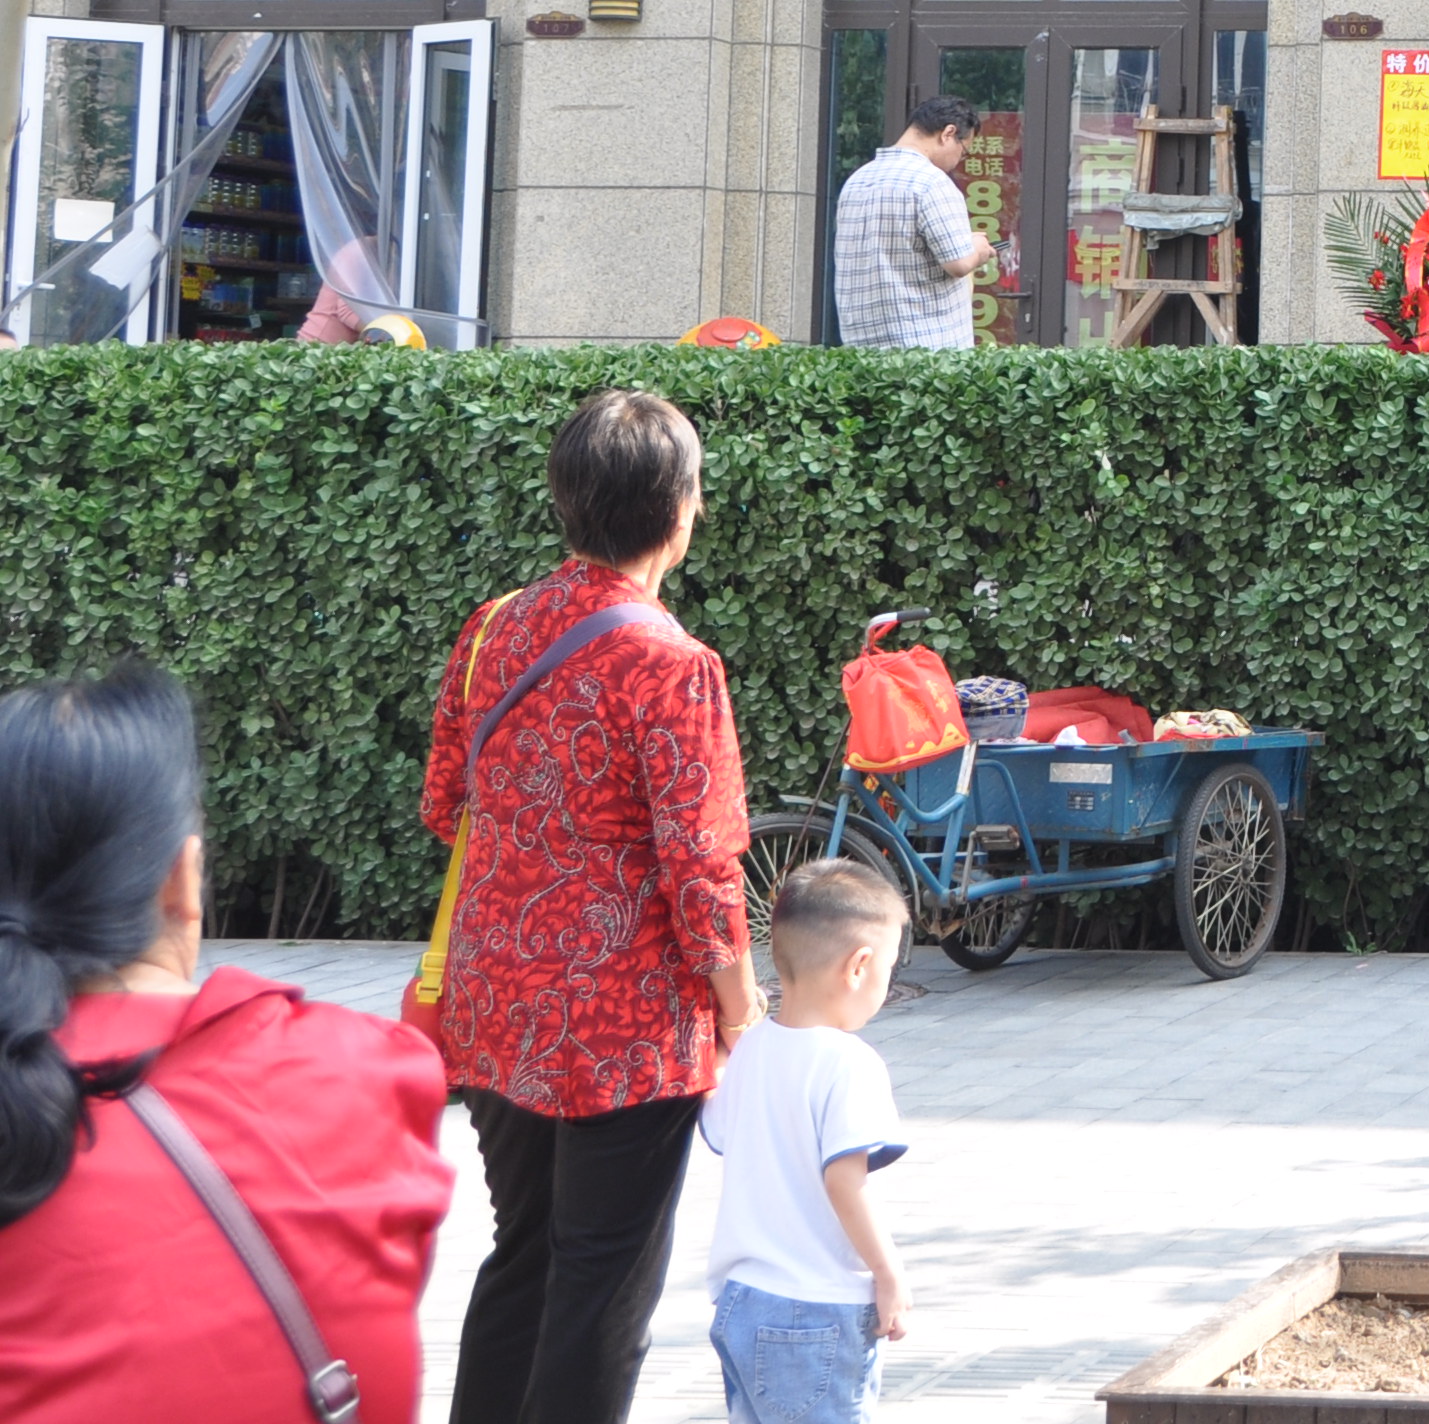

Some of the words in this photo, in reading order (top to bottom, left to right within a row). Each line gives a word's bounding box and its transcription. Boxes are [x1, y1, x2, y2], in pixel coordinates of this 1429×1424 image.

[544, 23, 569, 33] 107
[1341, 24, 1368, 35] 106
[964, 157, 1004, 177] 电话
